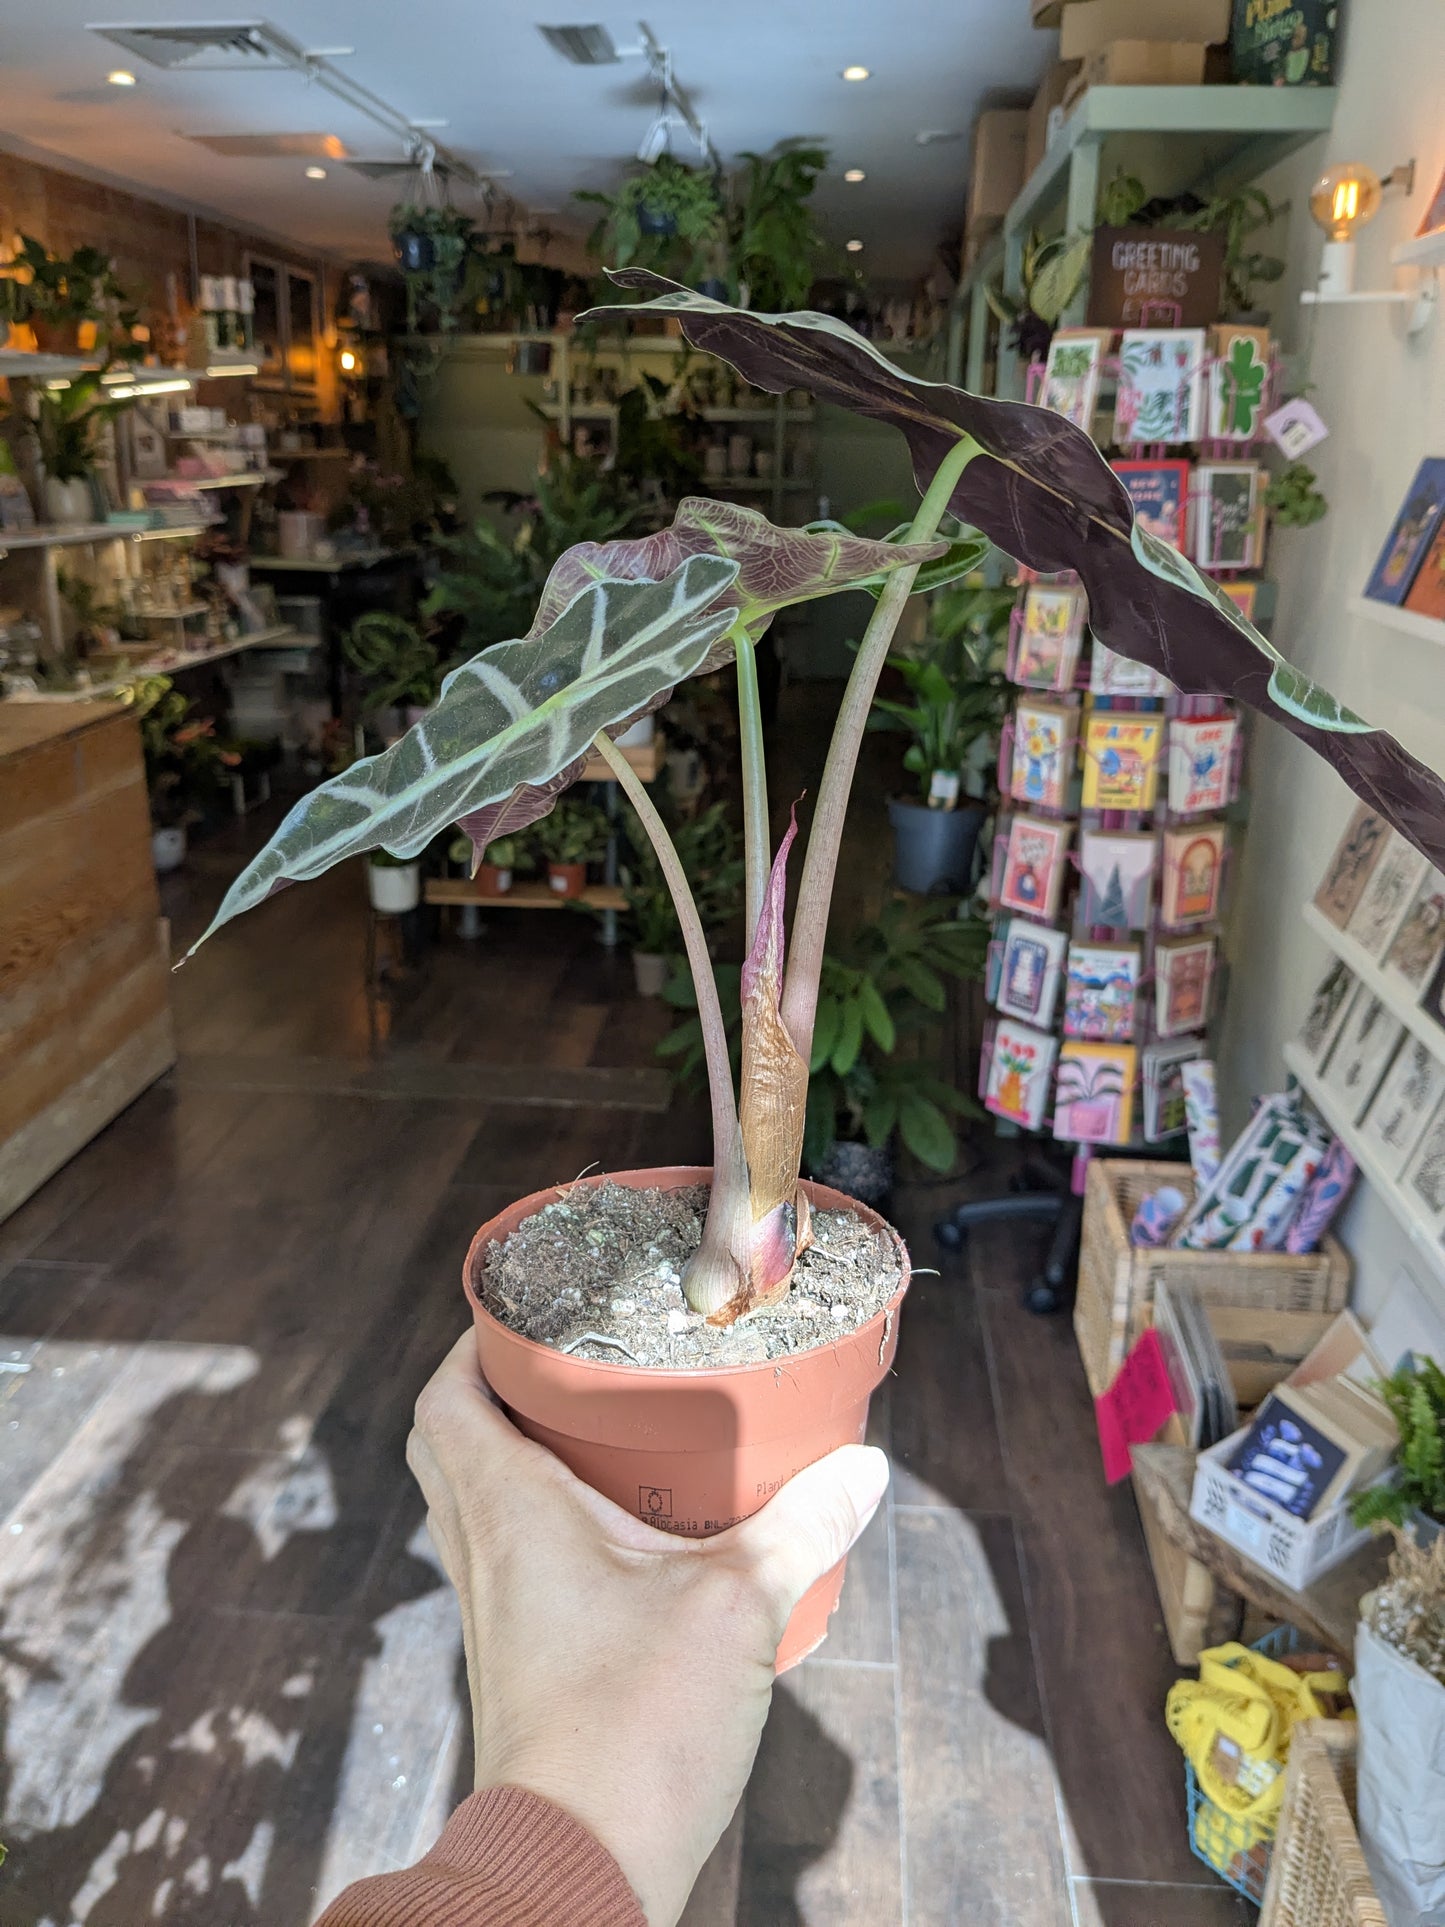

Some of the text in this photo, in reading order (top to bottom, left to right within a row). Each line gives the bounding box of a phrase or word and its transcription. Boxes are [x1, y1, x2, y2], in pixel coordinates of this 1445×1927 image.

[1112, 241, 1200, 272] GREETING
[1123, 269, 1188, 297] CARDS
[756, 1474, 784, 1497] Plant
[651, 1516, 698, 1531] Alocasia
